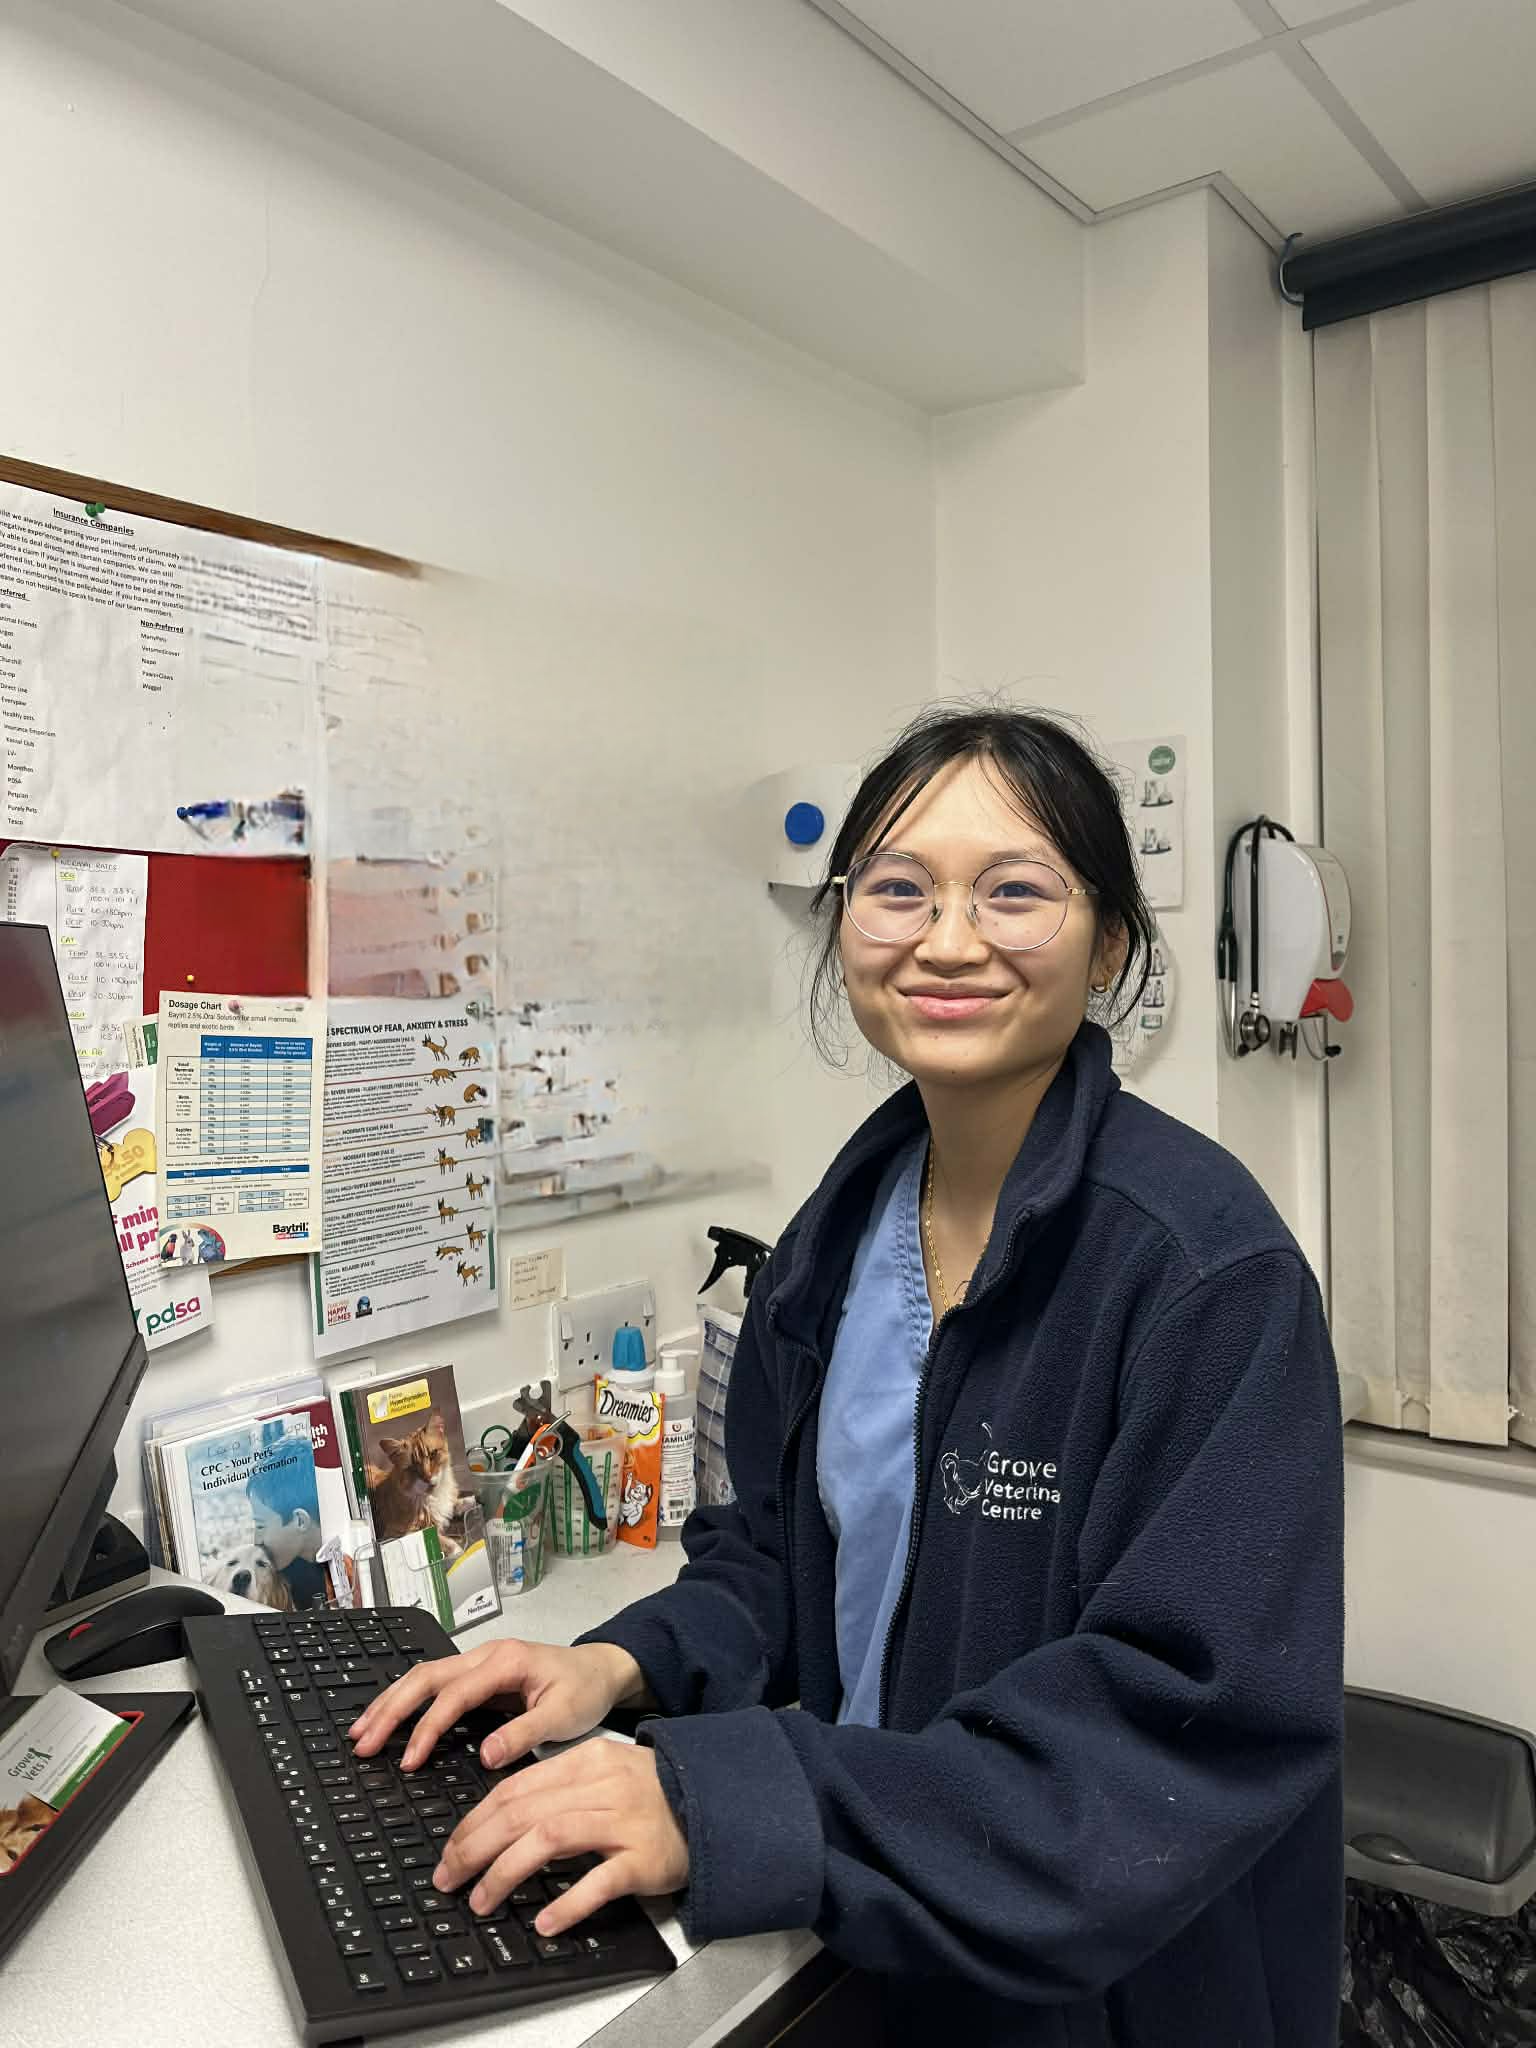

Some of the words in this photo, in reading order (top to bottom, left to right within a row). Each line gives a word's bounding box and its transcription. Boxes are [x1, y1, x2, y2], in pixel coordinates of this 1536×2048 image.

[53, 507, 88, 525] Insurance
[90, 520, 135, 535] Companies
[24, 517, 43, 527] always
[64, 528, 84, 540] getting
[138, 546, 180, 560] unfortunately
[28, 528, 62, 542] experiences
[76, 542, 99, 552] delayed
[23, 547, 39, 556] claim
[77, 562, 99, 573] insured
[100, 568, 115, 576] with
[120, 573, 147, 584] company
[29, 539, 42, 547] deal
[44, 543, 65, 554] directly
[66, 550, 79, 558] with
[80, 554, 101, 564] certain
[103, 558, 136, 570] companies.
[162, 570, 174, 578] still
[7, 565, 21, 573] then
[22, 570, 57, 582] reimbursed
[49, 565, 59, 573] any
[60, 567, 88, 580] treatment
[90, 576, 108, 585] would
[142, 587, 156, 595] paid
[38, 583, 61, 593] hesitate
[69, 591, 86, 600] speak
[127, 604, 142, 612] team
[144, 607, 173, 618] members.
[169, 1000, 198, 1010] Dosage
[200, 1001, 222, 1010] Chart
[168, 1022, 188, 1030] reptiles
[331, 1025, 372, 1036] SPECTRUM
[372, 1024, 383, 1033] OF
[384, 1023, 405, 1033] FEAR,
[406, 1021, 436, 1030] ANXIETY
[438, 1020, 444, 1028] &
[444, 1018, 469, 1028] STRESS
[119, 1230, 135, 1252] ll
[137, 1227, 159, 1251] pr
[272, 1223, 308, 1234] Baytril
[125, 1256, 148, 1270] Scheme
[146, 1296, 201, 1336] pdsa
[600, 1390, 654, 1423] Dreamies
[311, 1424, 328, 1438] lth
[312, 1438, 326, 1449] ub
[201, 1462, 222, 1476] CPC
[231, 1456, 251, 1468] Your
[253, 1448, 273, 1461] Pet's
[202, 1468, 250, 1490] Individual
[252, 1455, 298, 1476] Cremation
[987, 1451, 1057, 1479] Grove
[985, 1478, 1061, 1504] Veterina
[982, 1499, 1042, 1521] Centre
[7, 1752, 35, 1777] Grove
[21, 1763, 45, 1781] Vets
[424, 1900, 438, 1911] W
[435, 1923, 450, 1932] Q
